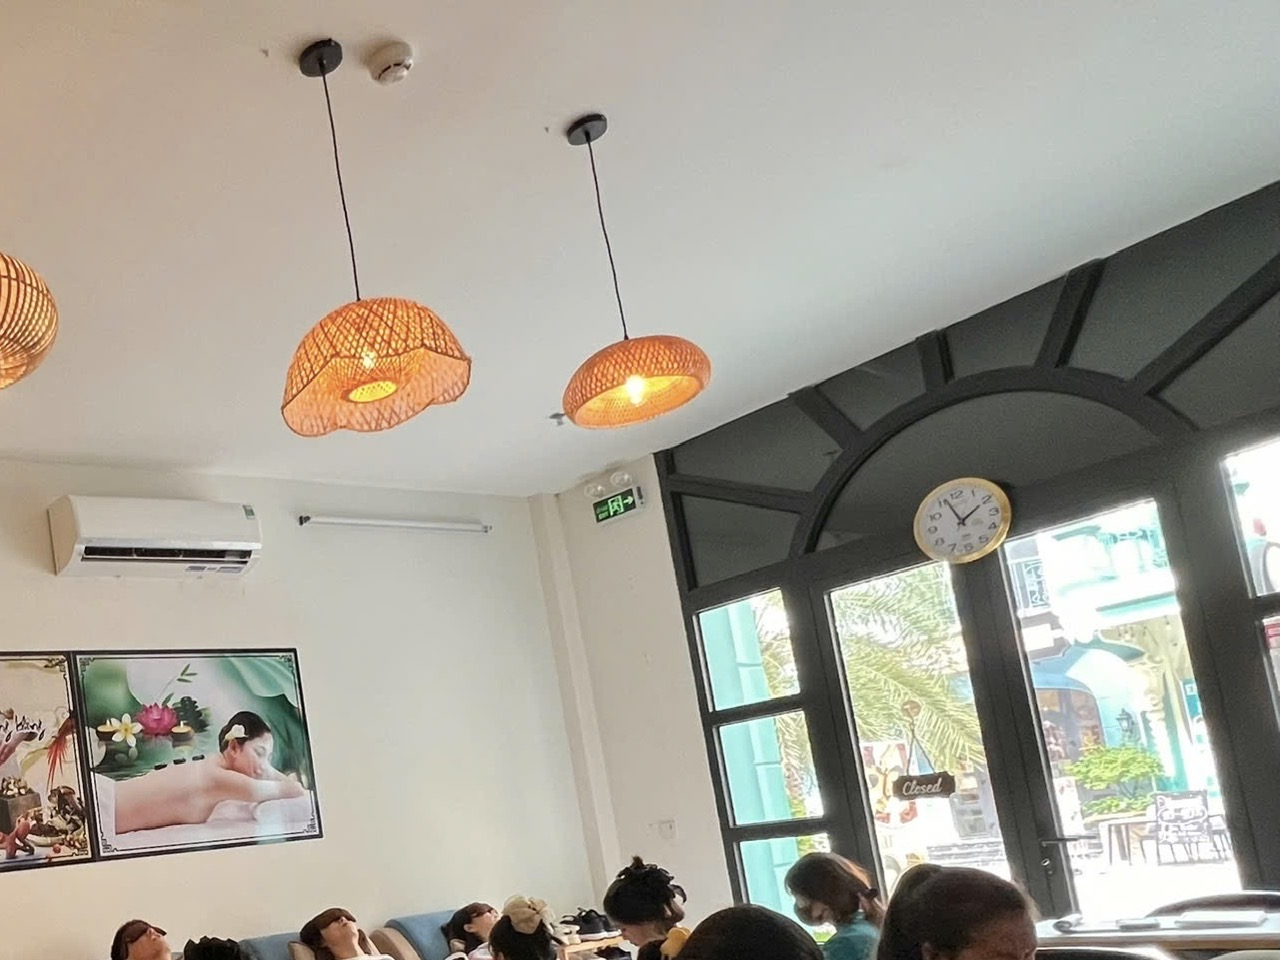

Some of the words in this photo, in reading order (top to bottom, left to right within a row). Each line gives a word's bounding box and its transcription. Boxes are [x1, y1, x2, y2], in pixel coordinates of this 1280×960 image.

[950, 490, 963, 500] 12
[982, 495, 992, 504] 2
[989, 507, 999, 516] 3
[929, 512, 942, 521] 10
[928, 526, 938, 534] 9
[988, 522, 997, 530] 4
[935, 537, 945, 546] 8
[979, 535, 988, 543] 5
[948, 543, 957, 552] 7
[964, 543, 974, 551] 6
[902, 778, 943, 796] Closed
